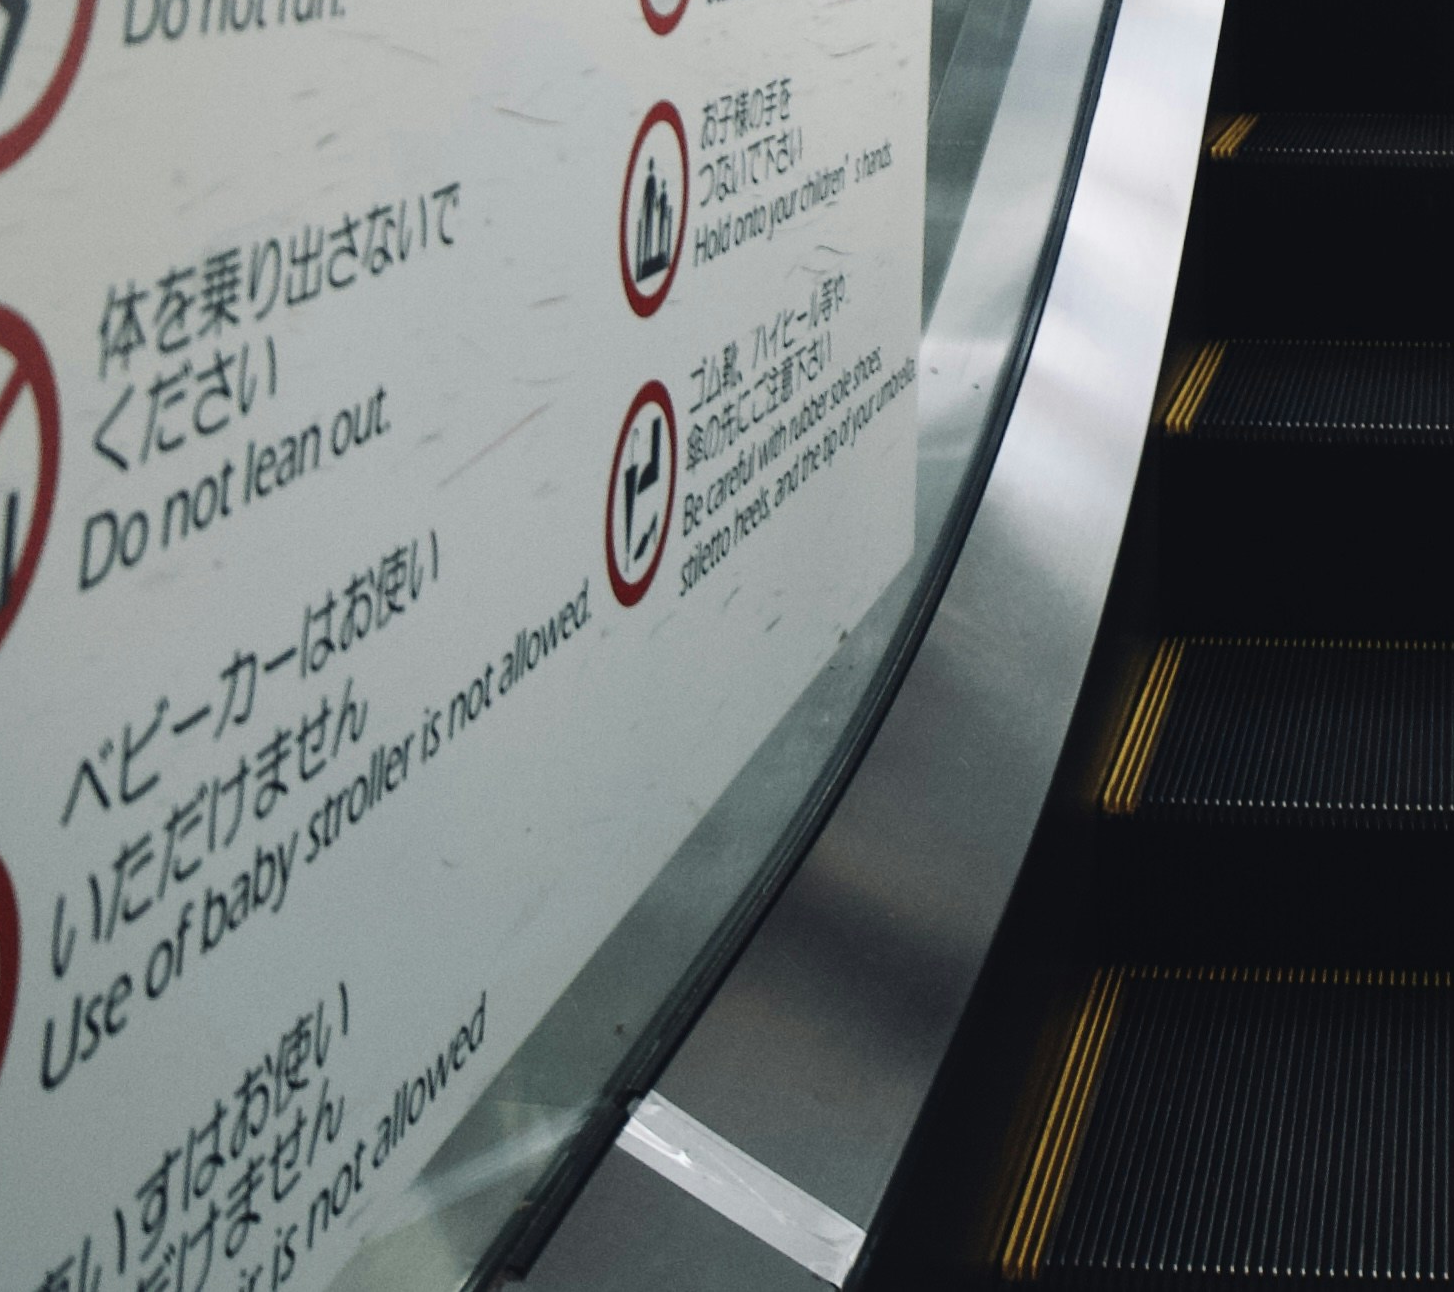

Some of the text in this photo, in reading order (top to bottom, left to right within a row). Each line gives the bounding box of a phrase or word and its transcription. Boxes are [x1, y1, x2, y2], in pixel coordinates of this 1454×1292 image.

[699, 127, 803, 207] つないで下さい
[701, 78, 791, 149] お子様の手を
[99, 182, 460, 377] 体を乗り出さないで
[693, 214, 731, 267] Hold
[734, 205, 766, 245] onto
[767, 190, 796, 241] your
[78, 385, 390, 592] Do not lean out.
[94, 335, 276, 470] ください
[679, 525, 731, 597] stiletto
[774, 454, 799, 507] and
[801, 442, 821, 483] the
[823, 426, 837, 466] tip
[840, 407, 851, 446] of
[851, 394, 874, 447] your
[683, 492, 703, 536] Be
[707, 443, 755, 515] careful
[758, 419, 787, 471] with
[790, 389, 829, 441] rubber
[830, 366, 850, 410] sole
[686, 331, 831, 470] 傘の先にご注意下さい
[61, 529, 438, 827] ベビーカーはお使い
[42, 577, 591, 1090] Use of baby stroller is not allowed.
[52, 678, 367, 978] いただけません
[308, 1140, 366, 1250] not
[372, 991, 487, 1169] allowed
